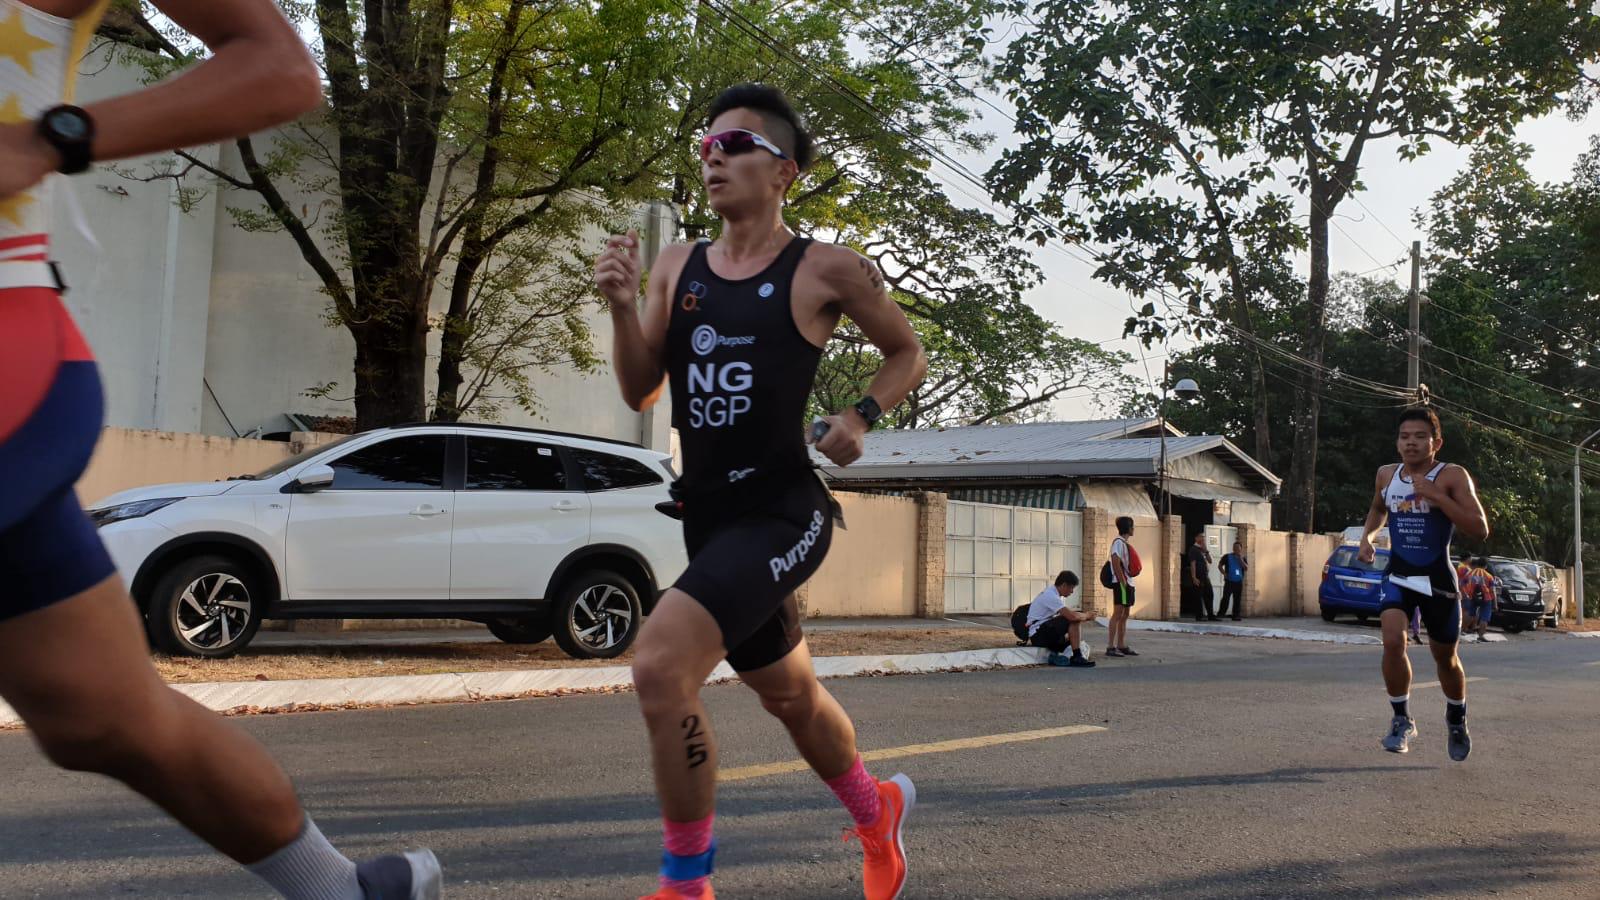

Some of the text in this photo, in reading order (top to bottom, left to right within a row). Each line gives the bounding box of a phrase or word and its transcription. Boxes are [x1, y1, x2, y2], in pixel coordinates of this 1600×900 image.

[688, 361, 753, 394] NG
[689, 396, 752, 429] SGP
[769, 510, 824, 582] Purpose
[681, 714, 708, 768] 25
